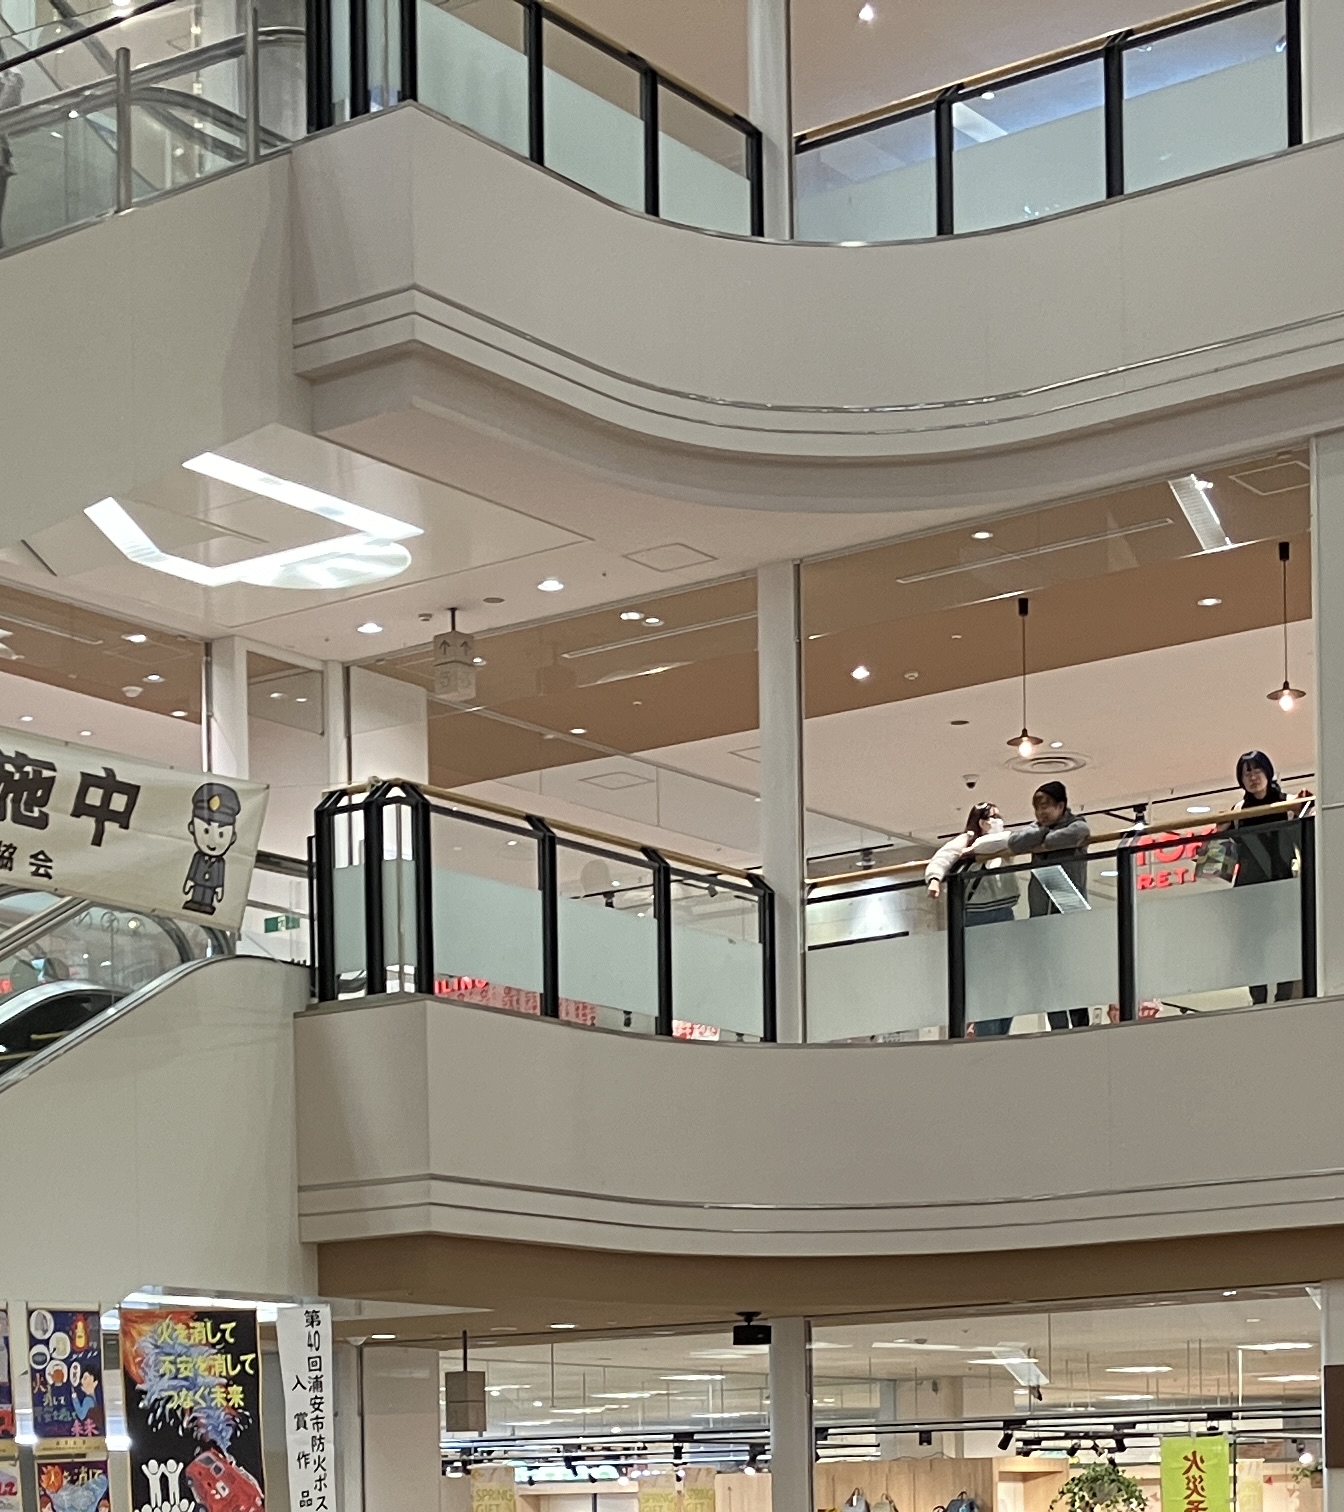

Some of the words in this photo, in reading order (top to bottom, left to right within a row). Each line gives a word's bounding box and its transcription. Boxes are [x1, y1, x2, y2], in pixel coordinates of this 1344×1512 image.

[157, 1318, 237, 1344] 火を消して
[159, 1352, 256, 1378] 不安を消して
[160, 1384, 245, 1410] つなぐ未来
[291, 1374, 313, 1508] 入賞作品
[475, 1488, 515, 1502] SPRING
